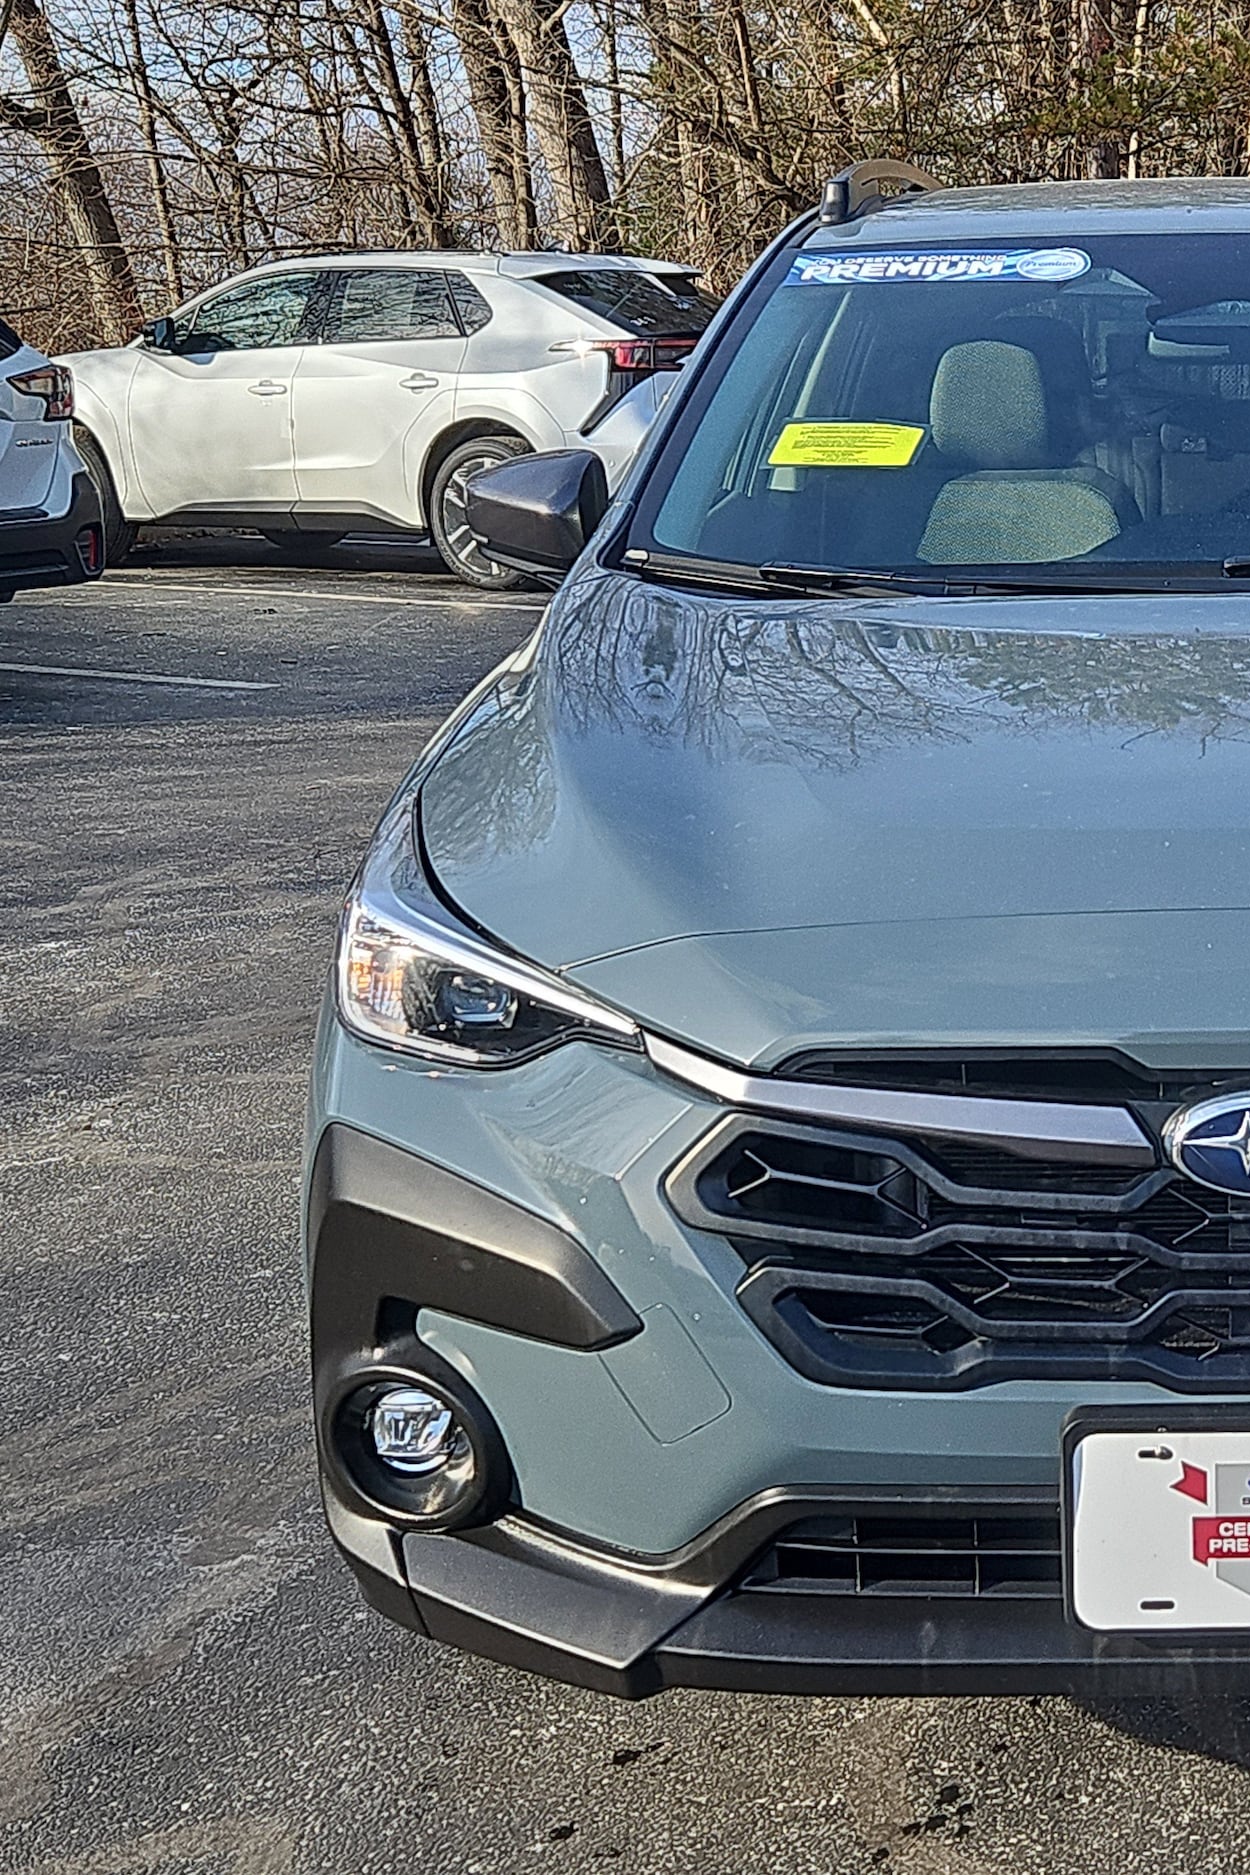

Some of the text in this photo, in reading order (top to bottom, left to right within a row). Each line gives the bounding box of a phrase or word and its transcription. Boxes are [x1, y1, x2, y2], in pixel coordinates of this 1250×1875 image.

[844, 255, 915, 265] DESERVE
[917, 253, 1008, 263] SOMETHING
[1023, 259, 1077, 268] Premium
[801, 260, 1004, 281] PREMIUM
